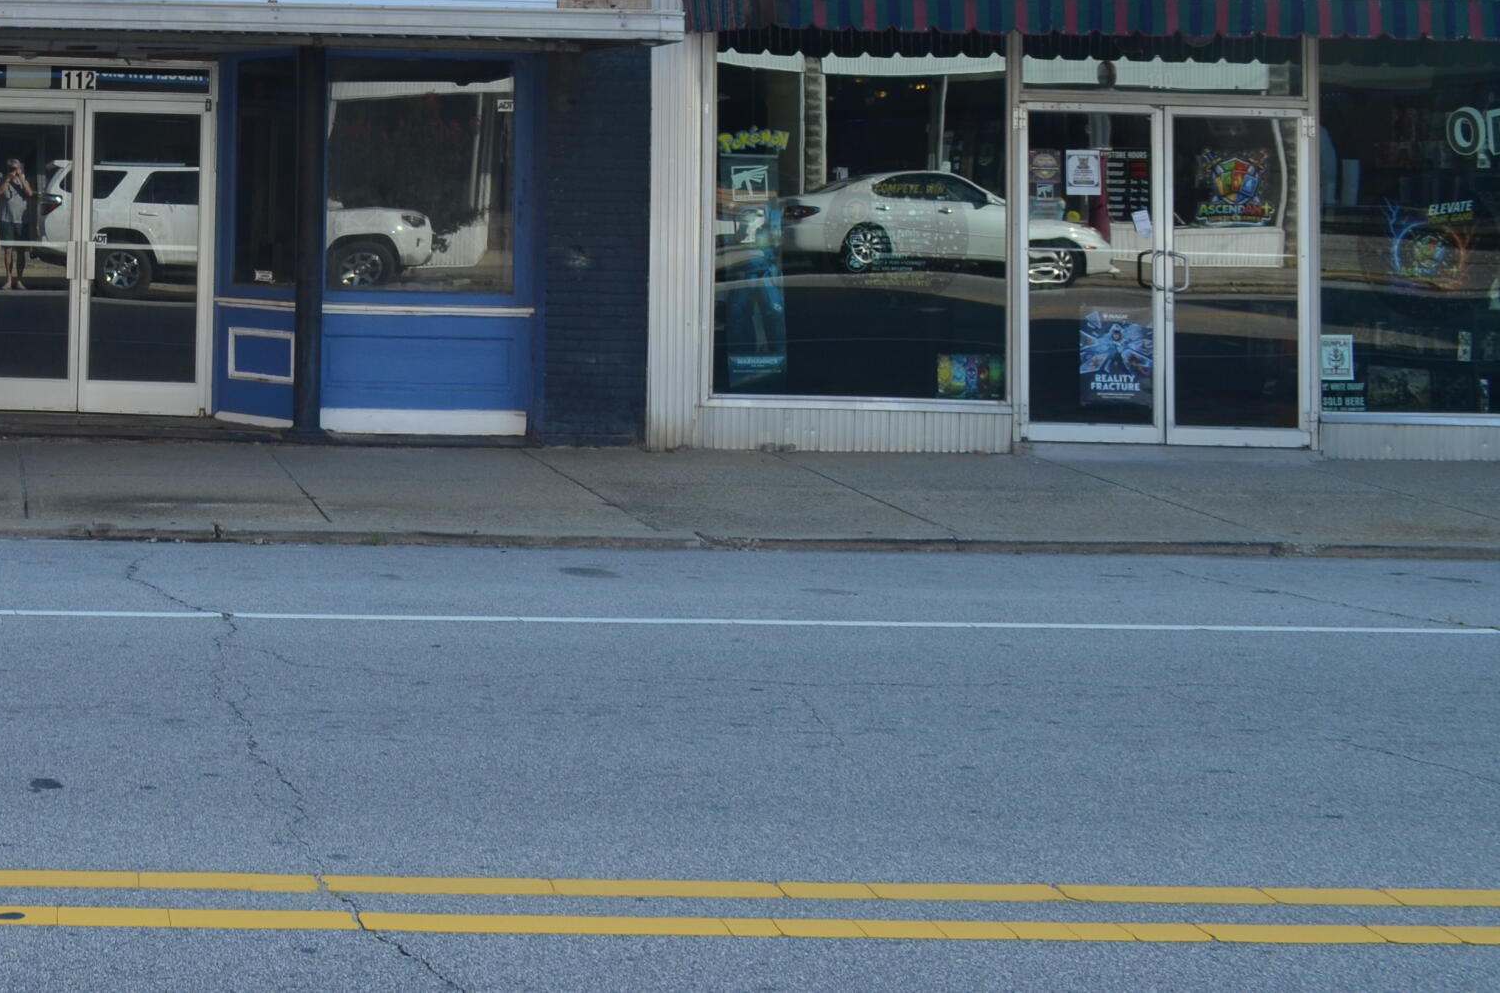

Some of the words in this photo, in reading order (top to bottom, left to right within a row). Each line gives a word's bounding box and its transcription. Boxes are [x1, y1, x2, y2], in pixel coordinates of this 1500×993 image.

[64, 72, 95, 89] 112
[1428, 199, 1474, 216] ELEVATE
[1094, 374, 1135, 383] REALITY
[1090, 382, 1140, 391] FRACTURE
[1322, 396, 1343, 406] SOLD
[1345, 396, 1365, 406] HERE
